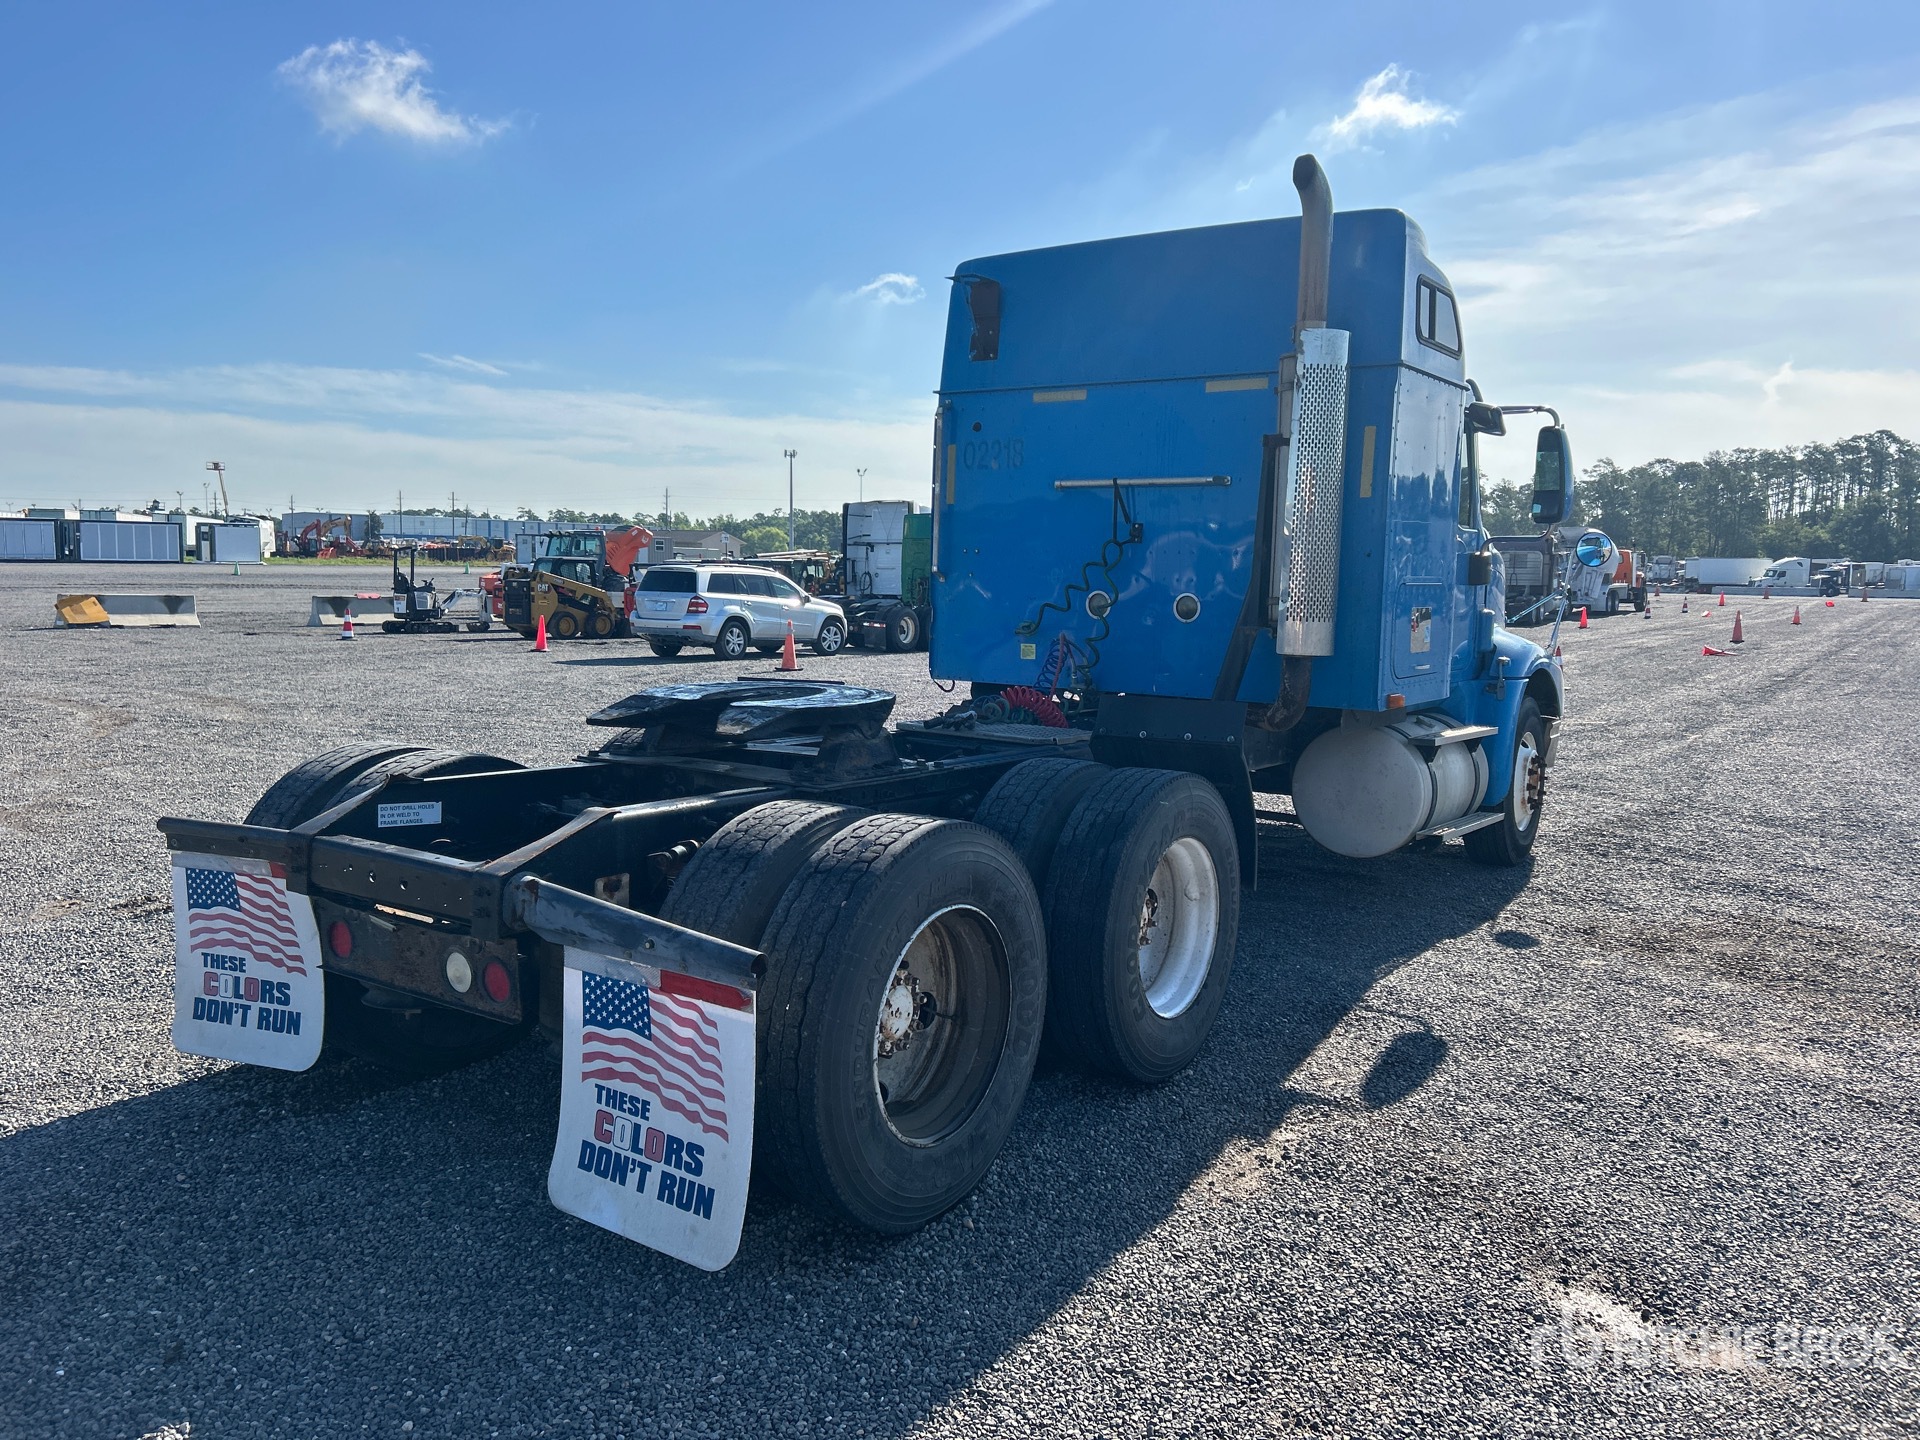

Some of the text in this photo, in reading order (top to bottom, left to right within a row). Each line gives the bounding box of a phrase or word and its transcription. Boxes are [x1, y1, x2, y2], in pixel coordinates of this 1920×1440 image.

[537, 583, 549, 592] CAT
[201, 952, 246, 972] THESE
[203, 971, 291, 1006] COLORS
[192, 997, 301, 1035] DON'T RUN
[594, 1083, 650, 1121] THESE
[594, 1109, 704, 1177] COLORS
[577, 1139, 715, 1221] DON'T RUN
